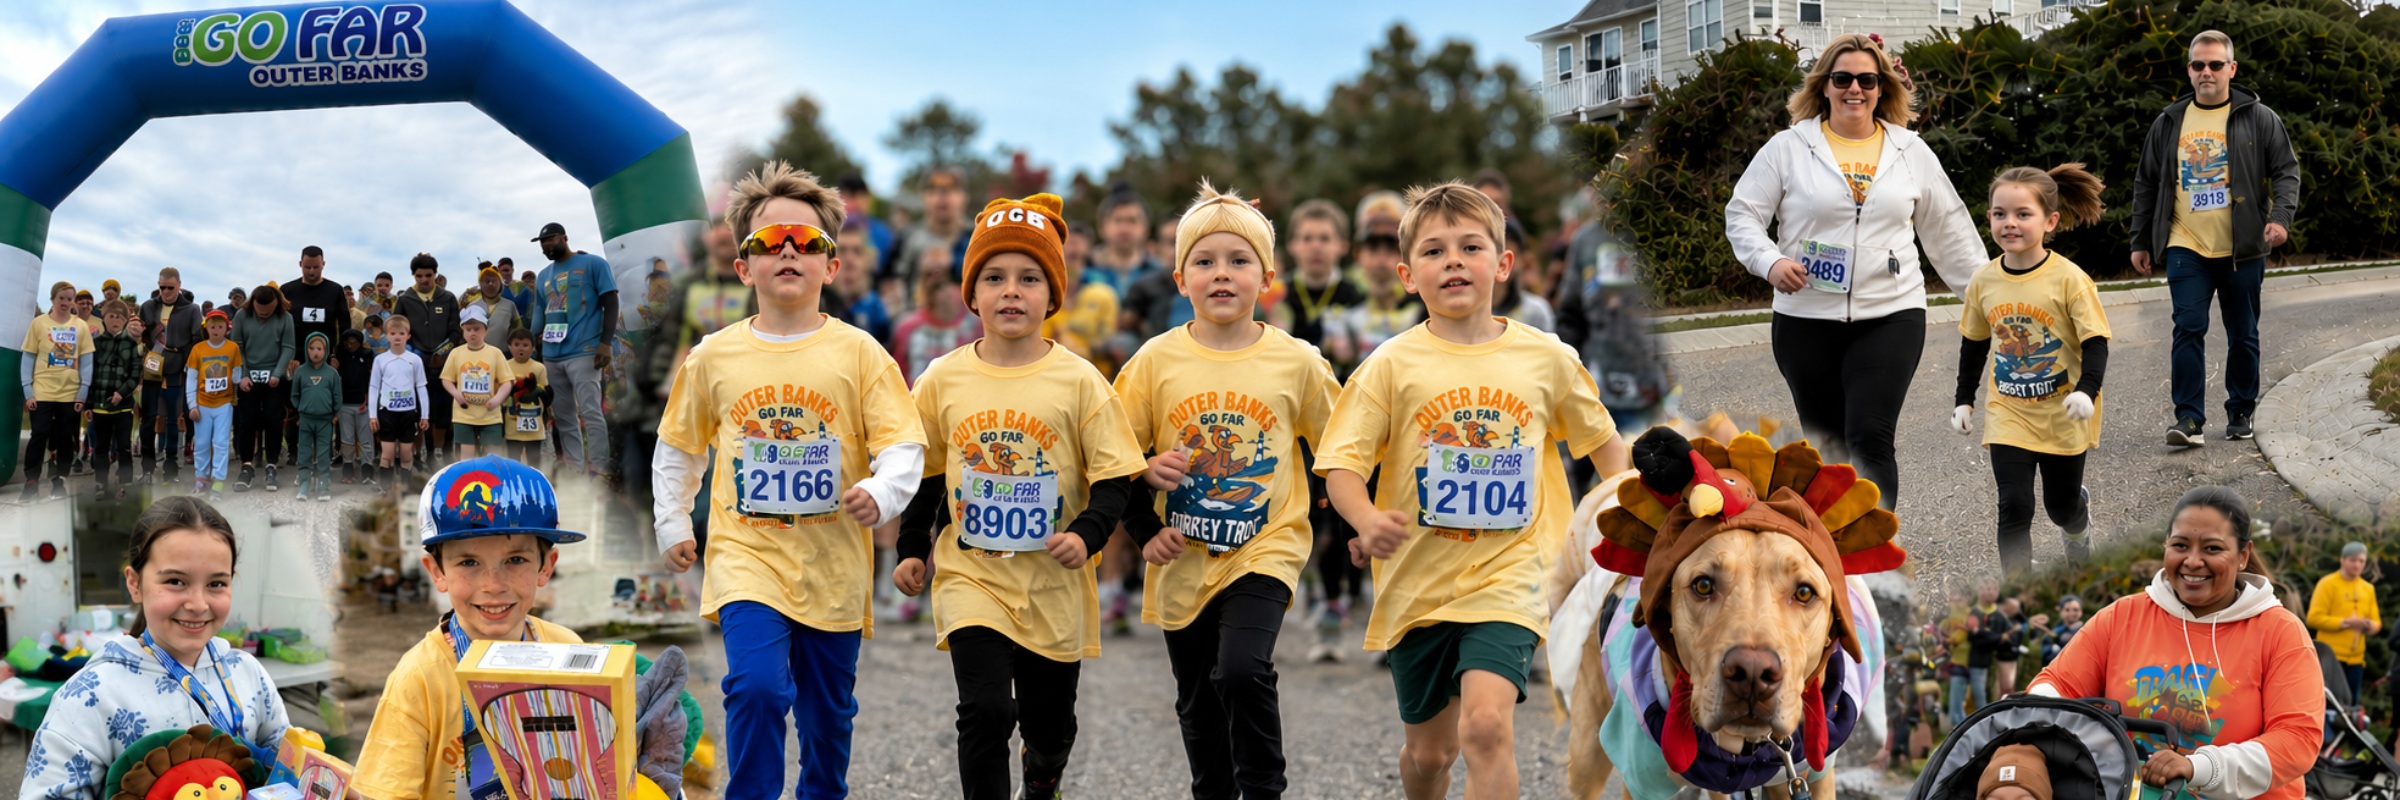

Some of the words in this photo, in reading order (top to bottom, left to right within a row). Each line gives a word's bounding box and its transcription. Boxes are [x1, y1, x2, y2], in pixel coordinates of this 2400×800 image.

[193, 13, 288, 65] GO
[298, 5, 426, 60] FAR
[252, 66, 336, 86] OUTER
[341, 61, 426, 83] BANKS
[1801, 256, 1846, 284] 3489
[729, 384, 778, 426] OUTER
[782, 383, 839, 424] BANKS
[758, 407, 776, 420] GO
[780, 406, 804, 419] FAR
[1168, 391, 1219, 430] OUTER
[1224, 391, 1277, 432] BANKS
[1200, 413, 1217, 426] GO
[1221, 413, 1245, 427] FAR
[1415, 386, 1473, 430] OUTER
[1478, 386, 1533, 427] BANKS
[1453, 410, 1472, 423] GO
[1476, 409, 1501, 422] FAR
[952, 409, 999, 449] OUTER
[1003, 408, 1059, 451] BANKS
[980, 431, 998, 444] GO
[1001, 430, 1024, 444] FAR
[750, 468, 834, 502] 2166
[1435, 479, 1527, 516] 2104
[964, 503, 1048, 540] 8903
